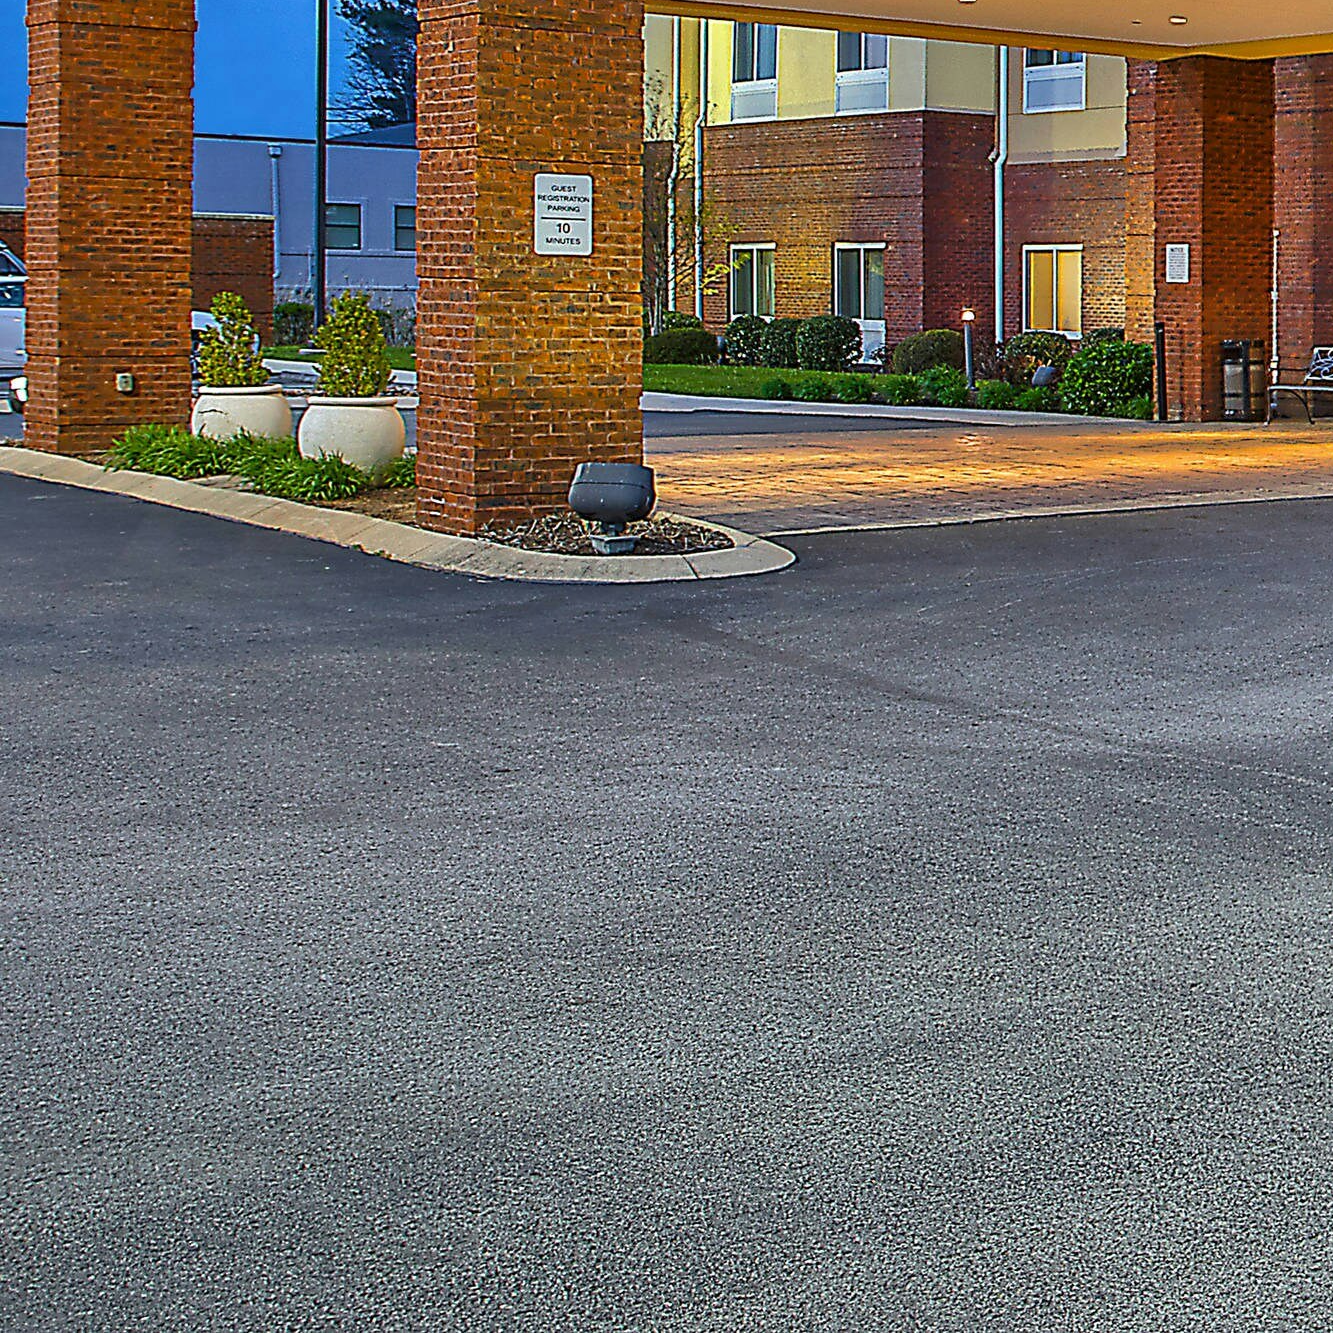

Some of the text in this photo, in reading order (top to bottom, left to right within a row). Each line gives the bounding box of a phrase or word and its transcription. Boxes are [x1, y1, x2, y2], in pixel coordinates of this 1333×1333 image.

[538, 195, 590, 203] REGISTRATION
[547, 205, 580, 213] PARKING
[556, 223, 571, 233] 10
[546, 237, 581, 245] MINUTES
